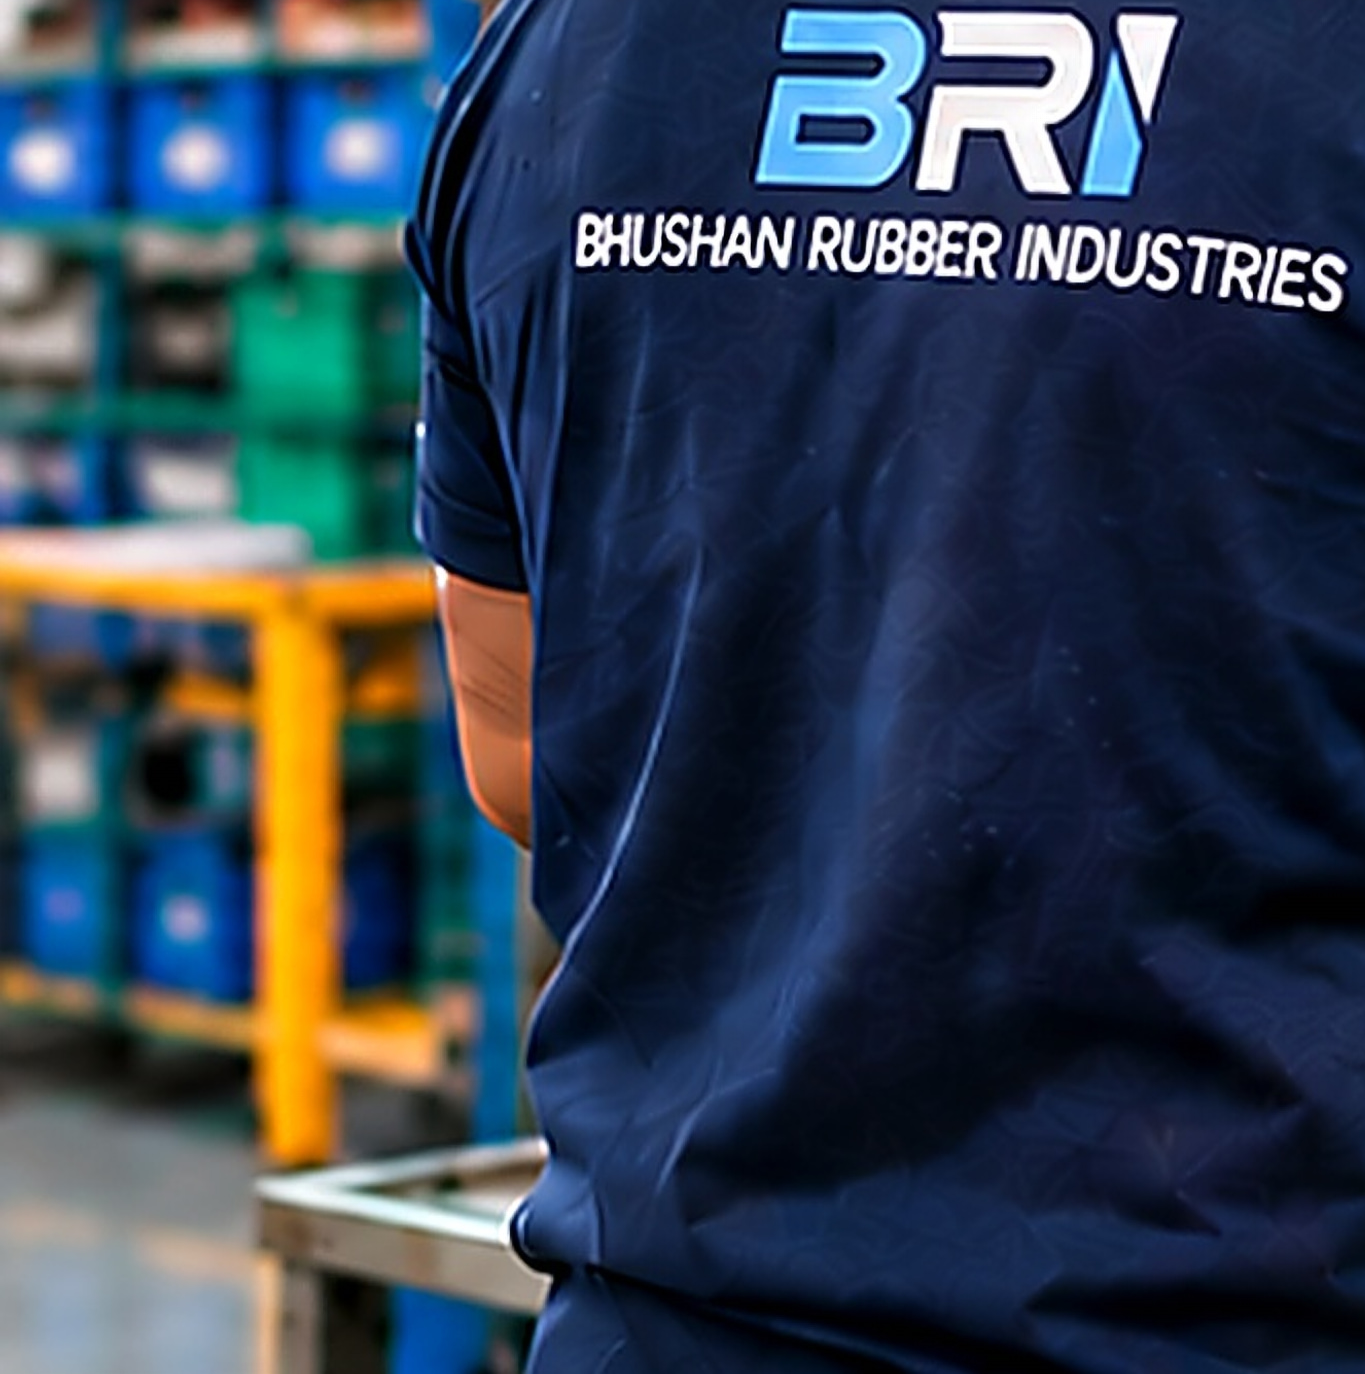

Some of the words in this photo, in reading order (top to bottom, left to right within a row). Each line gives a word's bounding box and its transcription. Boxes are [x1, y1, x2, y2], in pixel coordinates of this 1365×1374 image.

[574, 212, 795, 272] BHUSHAN
[807, 216, 1004, 280] RUBBER
[1015, 223, 1349, 313] INDUSTRIES
